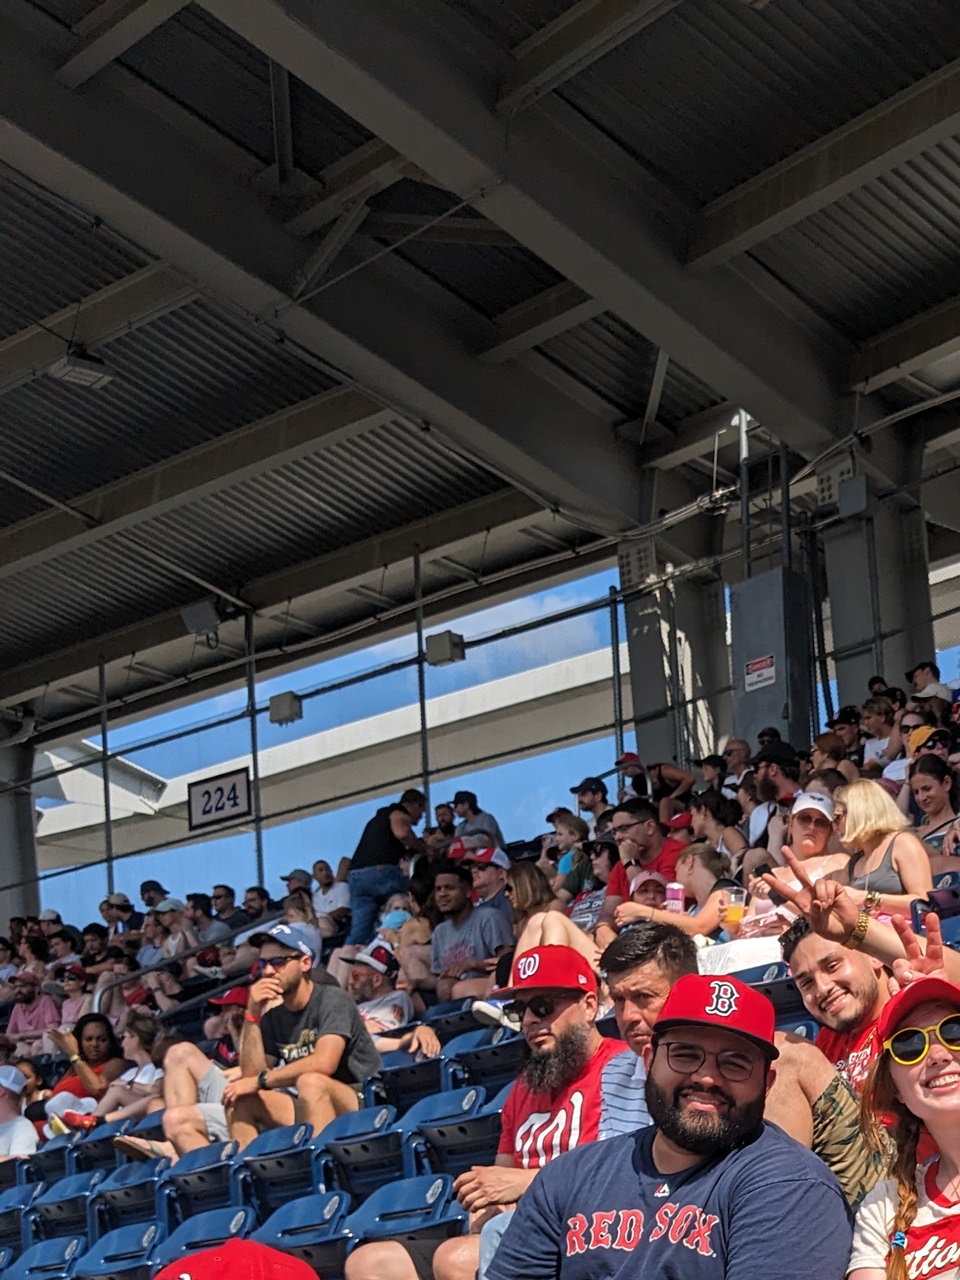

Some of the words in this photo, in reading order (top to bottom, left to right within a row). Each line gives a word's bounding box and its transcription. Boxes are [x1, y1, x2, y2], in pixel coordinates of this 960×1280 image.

[202, 783, 239, 816] 224
[705, 980, 740, 1017] B
[566, 1209, 645, 1256] RED
[649, 1202, 720, 1257] SOX
